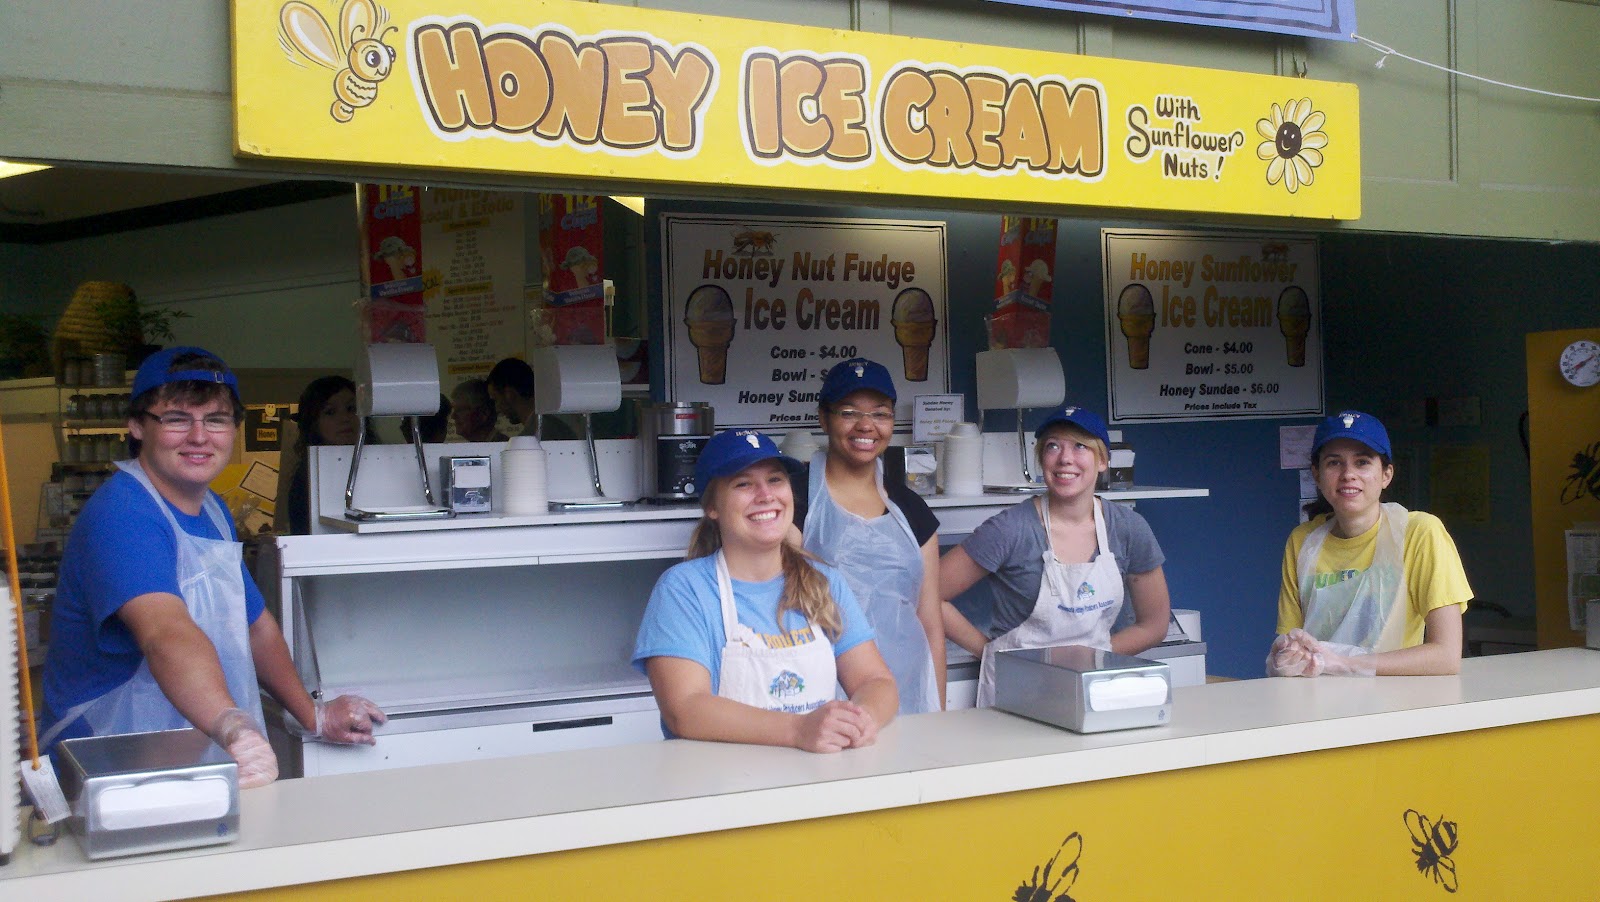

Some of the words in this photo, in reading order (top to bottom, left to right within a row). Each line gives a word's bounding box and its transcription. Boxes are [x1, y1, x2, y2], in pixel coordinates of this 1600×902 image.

[413, 21, 714, 151] HONEY
[744, 52, 872, 162] ICE
[880, 66, 1105, 178] CREAM
[1155, 95, 1201, 121] With
[1127, 104, 1244, 159] Sunflower
[703, 249, 784, 288] Honey
[791, 251, 836, 282] Nut
[843, 253, 915, 289] Fudge
[1130, 253, 1196, 287] Honey
[1200, 254, 1298, 283] Sunflower
[744, 287, 787, 330] Ice
[796, 287, 880, 331] Cream
[1161, 285, 1199, 328] Ice
[1203, 285, 1273, 329] Cream
[771, 346, 806, 359] Cone
[819, 345, 857, 360] $4.00
[1184, 342, 1213, 354] Cone
[1223, 341, 1253, 355] $4.00
[772, 368, 807, 382] Bowl
[1185, 363, 1214, 375] Bowl
[1224, 362, 1254, 375] $5.00
[738, 391, 784, 406] Honey
[788, 389, 820, 403] Sund
[1159, 383, 1196, 398] Honey
[1199, 383, 1240, 396] Sundae
[1250, 382, 1279, 395] $6.00
[1211, 402, 1241, 410] Include
[1243, 402, 1257, 410] Tax
[769, 414, 801, 422] Prices
